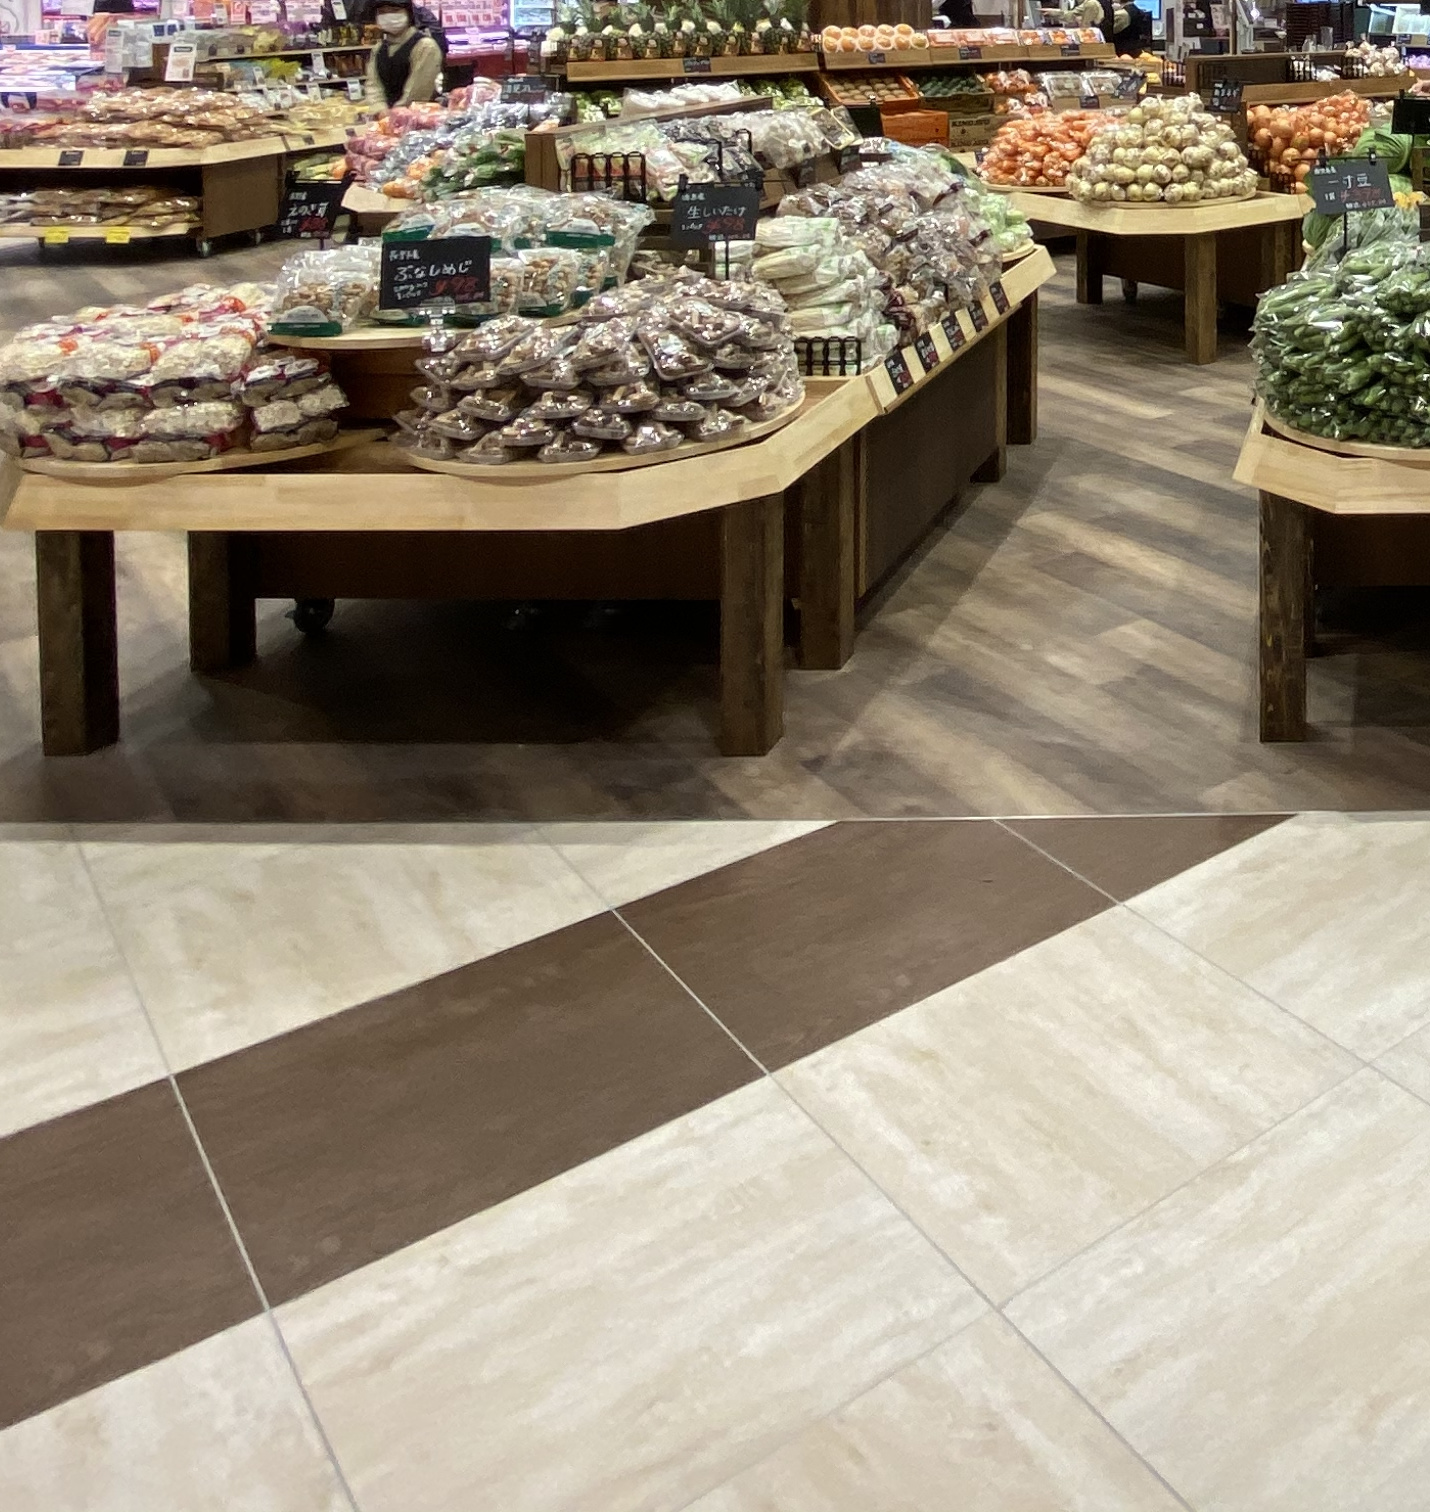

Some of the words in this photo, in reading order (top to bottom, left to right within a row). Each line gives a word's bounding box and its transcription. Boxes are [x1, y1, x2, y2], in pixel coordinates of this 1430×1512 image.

[687, 205, 747, 220] 生しいたけ
[394, 259, 473, 282] ぶなしめじ
